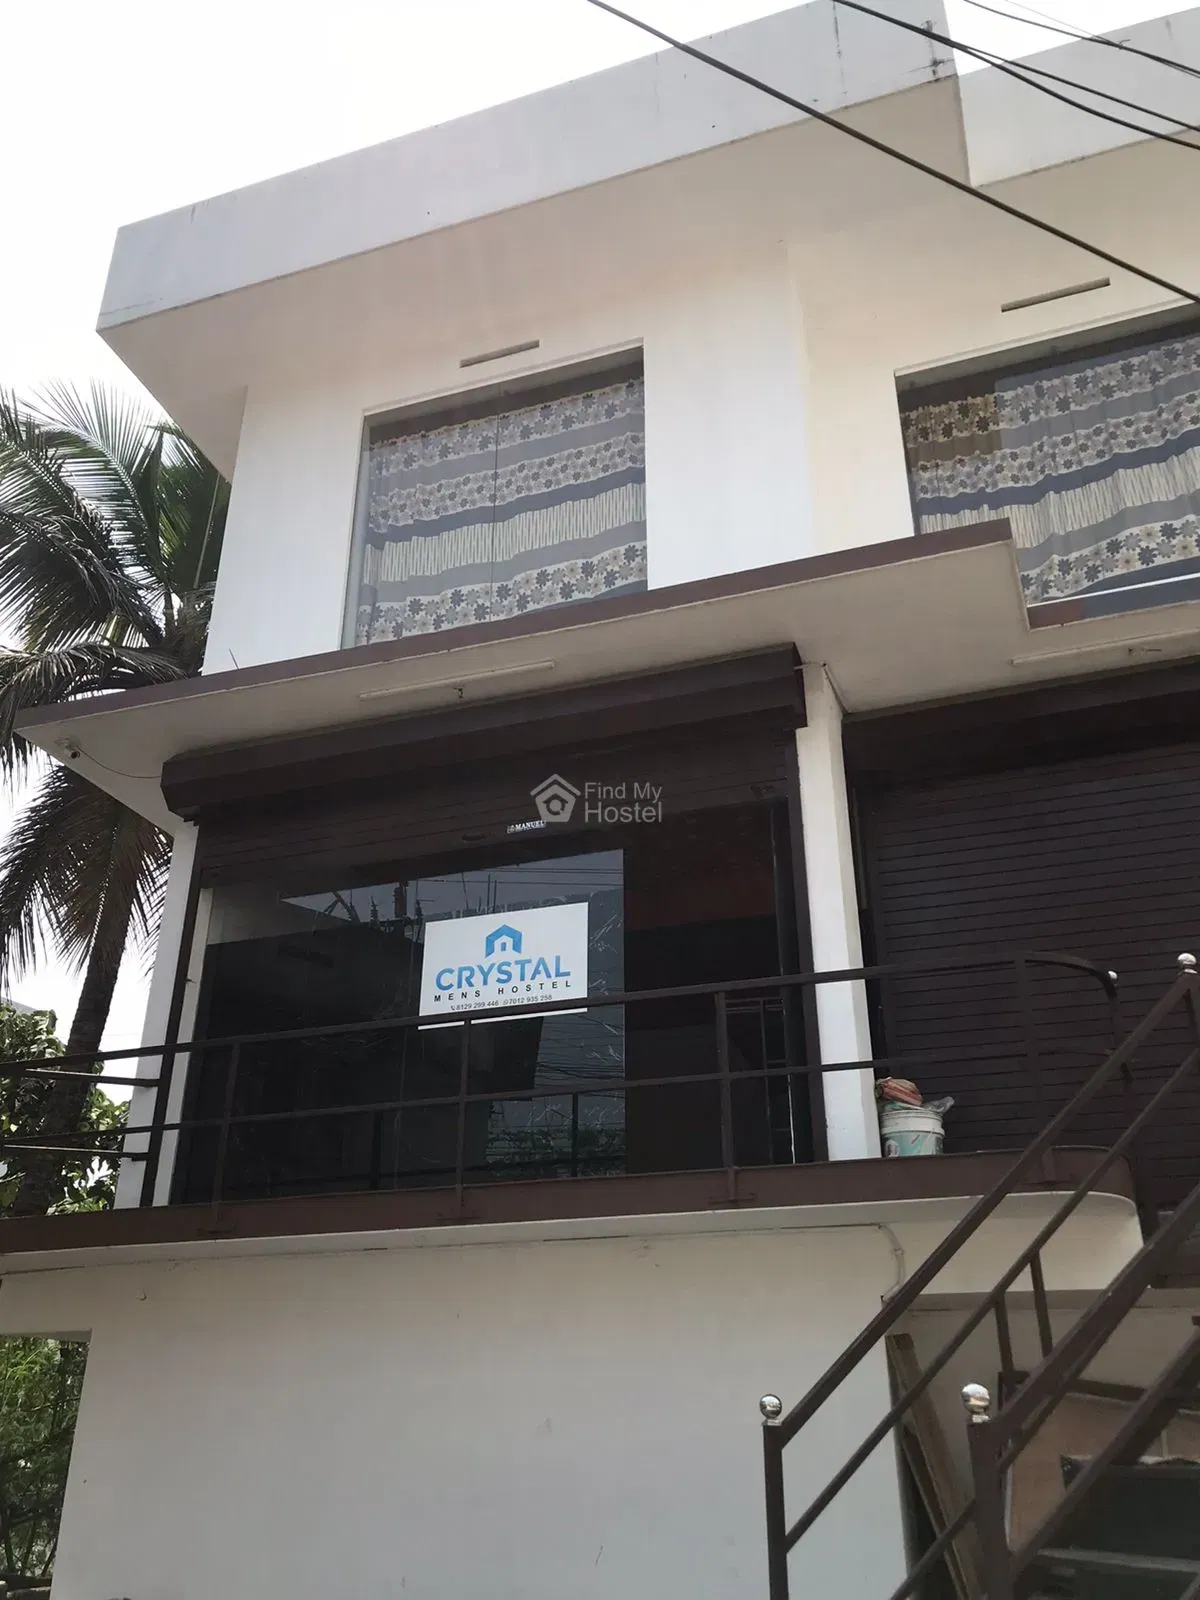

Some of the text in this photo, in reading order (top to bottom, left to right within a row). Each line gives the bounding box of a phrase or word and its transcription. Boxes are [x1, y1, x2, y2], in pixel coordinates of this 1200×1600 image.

[435, 955, 571, 991] CRYSTAL
[434, 980, 571, 1002] MENS HOSTEL
